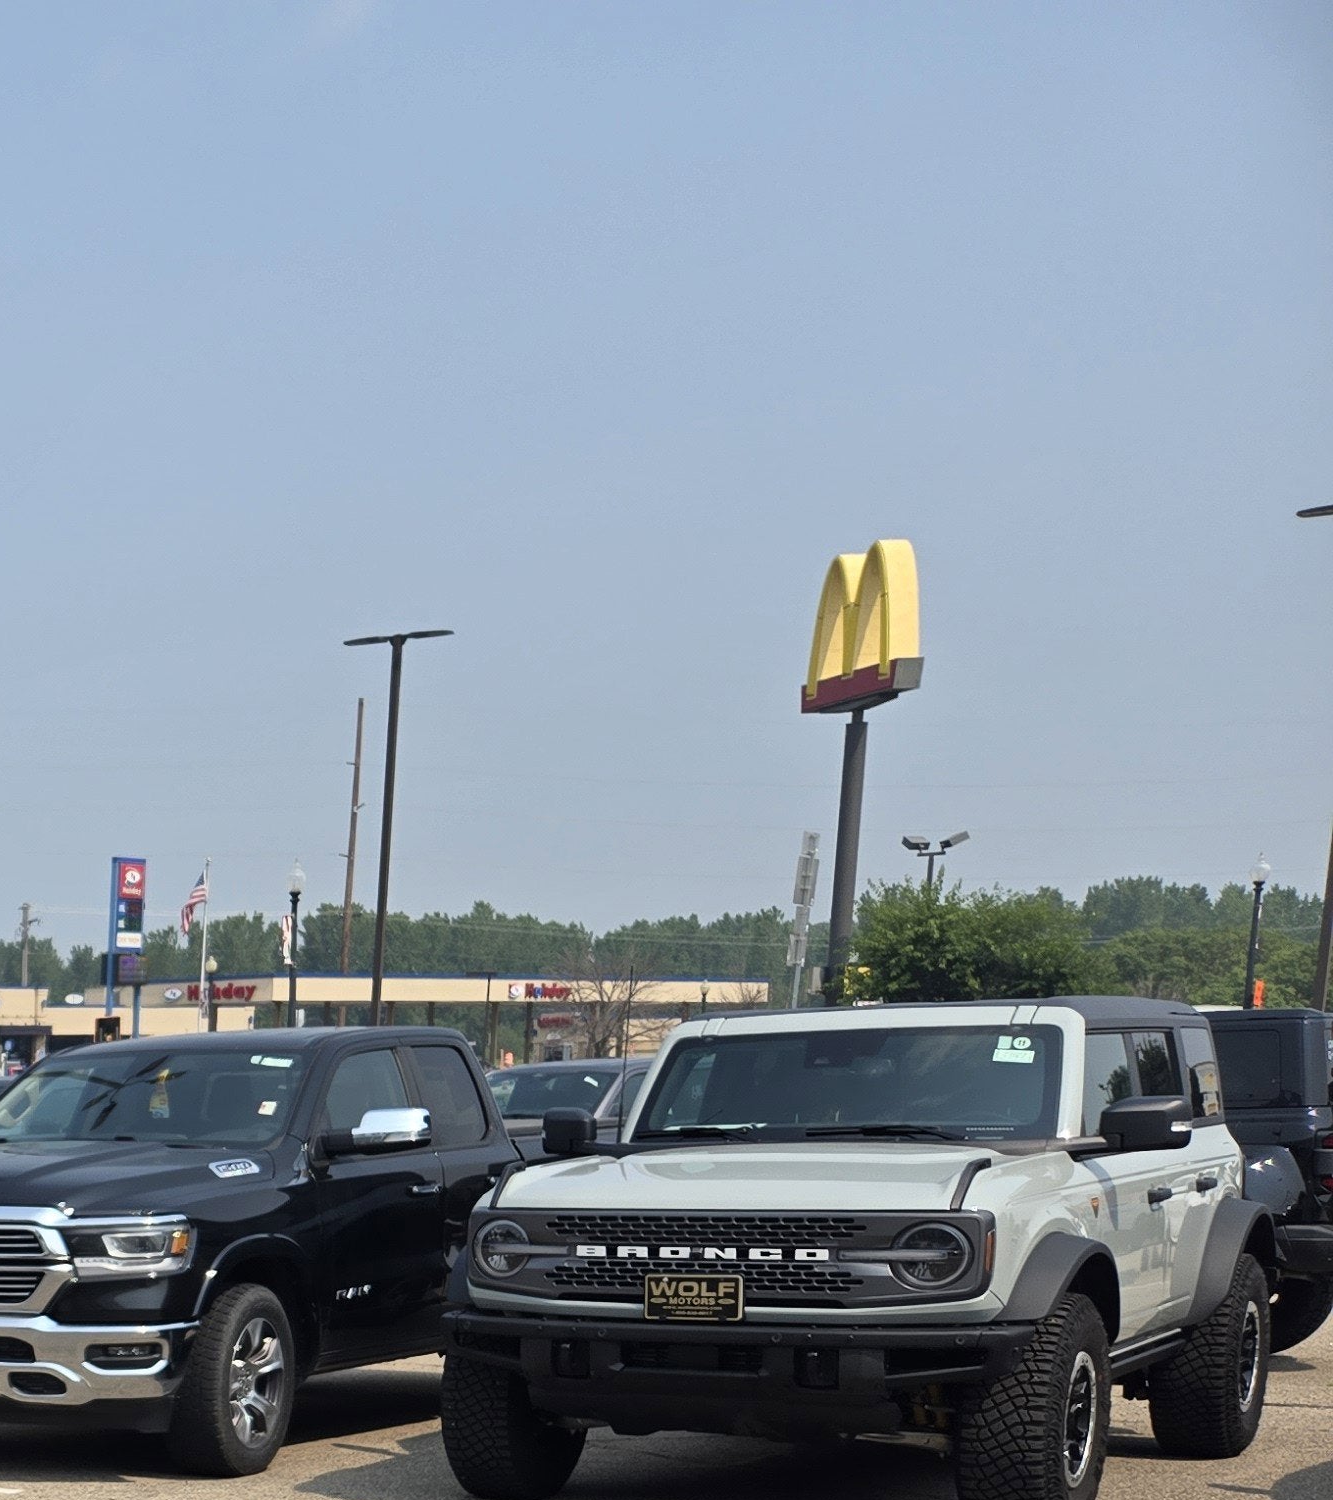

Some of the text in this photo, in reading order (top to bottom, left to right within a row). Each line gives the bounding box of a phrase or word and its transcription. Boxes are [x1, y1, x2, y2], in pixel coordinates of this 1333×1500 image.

[576, 1245, 829, 1261] BRONCO
[650, 1281, 735, 1297] WOLF
[669, 1297, 716, 1305] MOTORS
